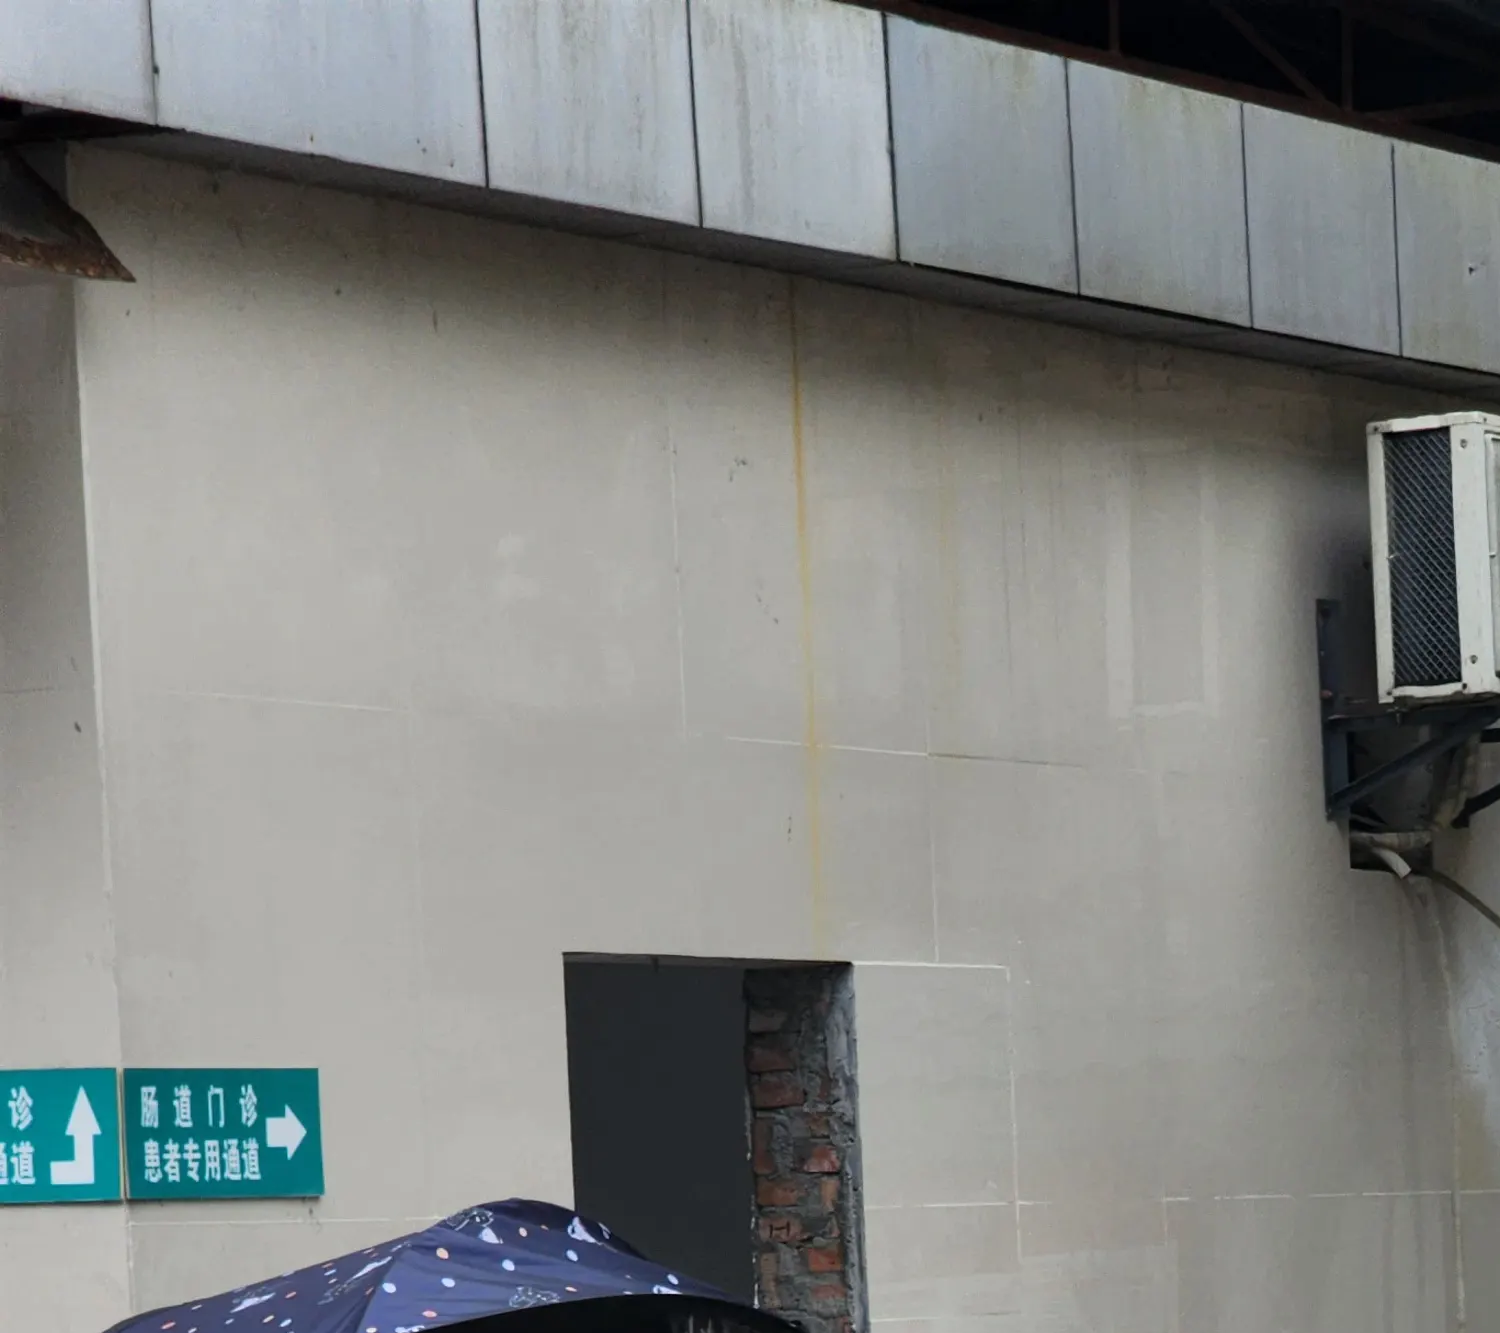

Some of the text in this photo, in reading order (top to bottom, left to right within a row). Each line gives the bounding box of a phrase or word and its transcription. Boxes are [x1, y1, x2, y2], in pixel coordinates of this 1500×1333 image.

[8, 1085, 33, 1131] 诊
[140, 1083, 258, 1128] 肠道门诊
[143, 1137, 261, 1183] 患者专用通道
